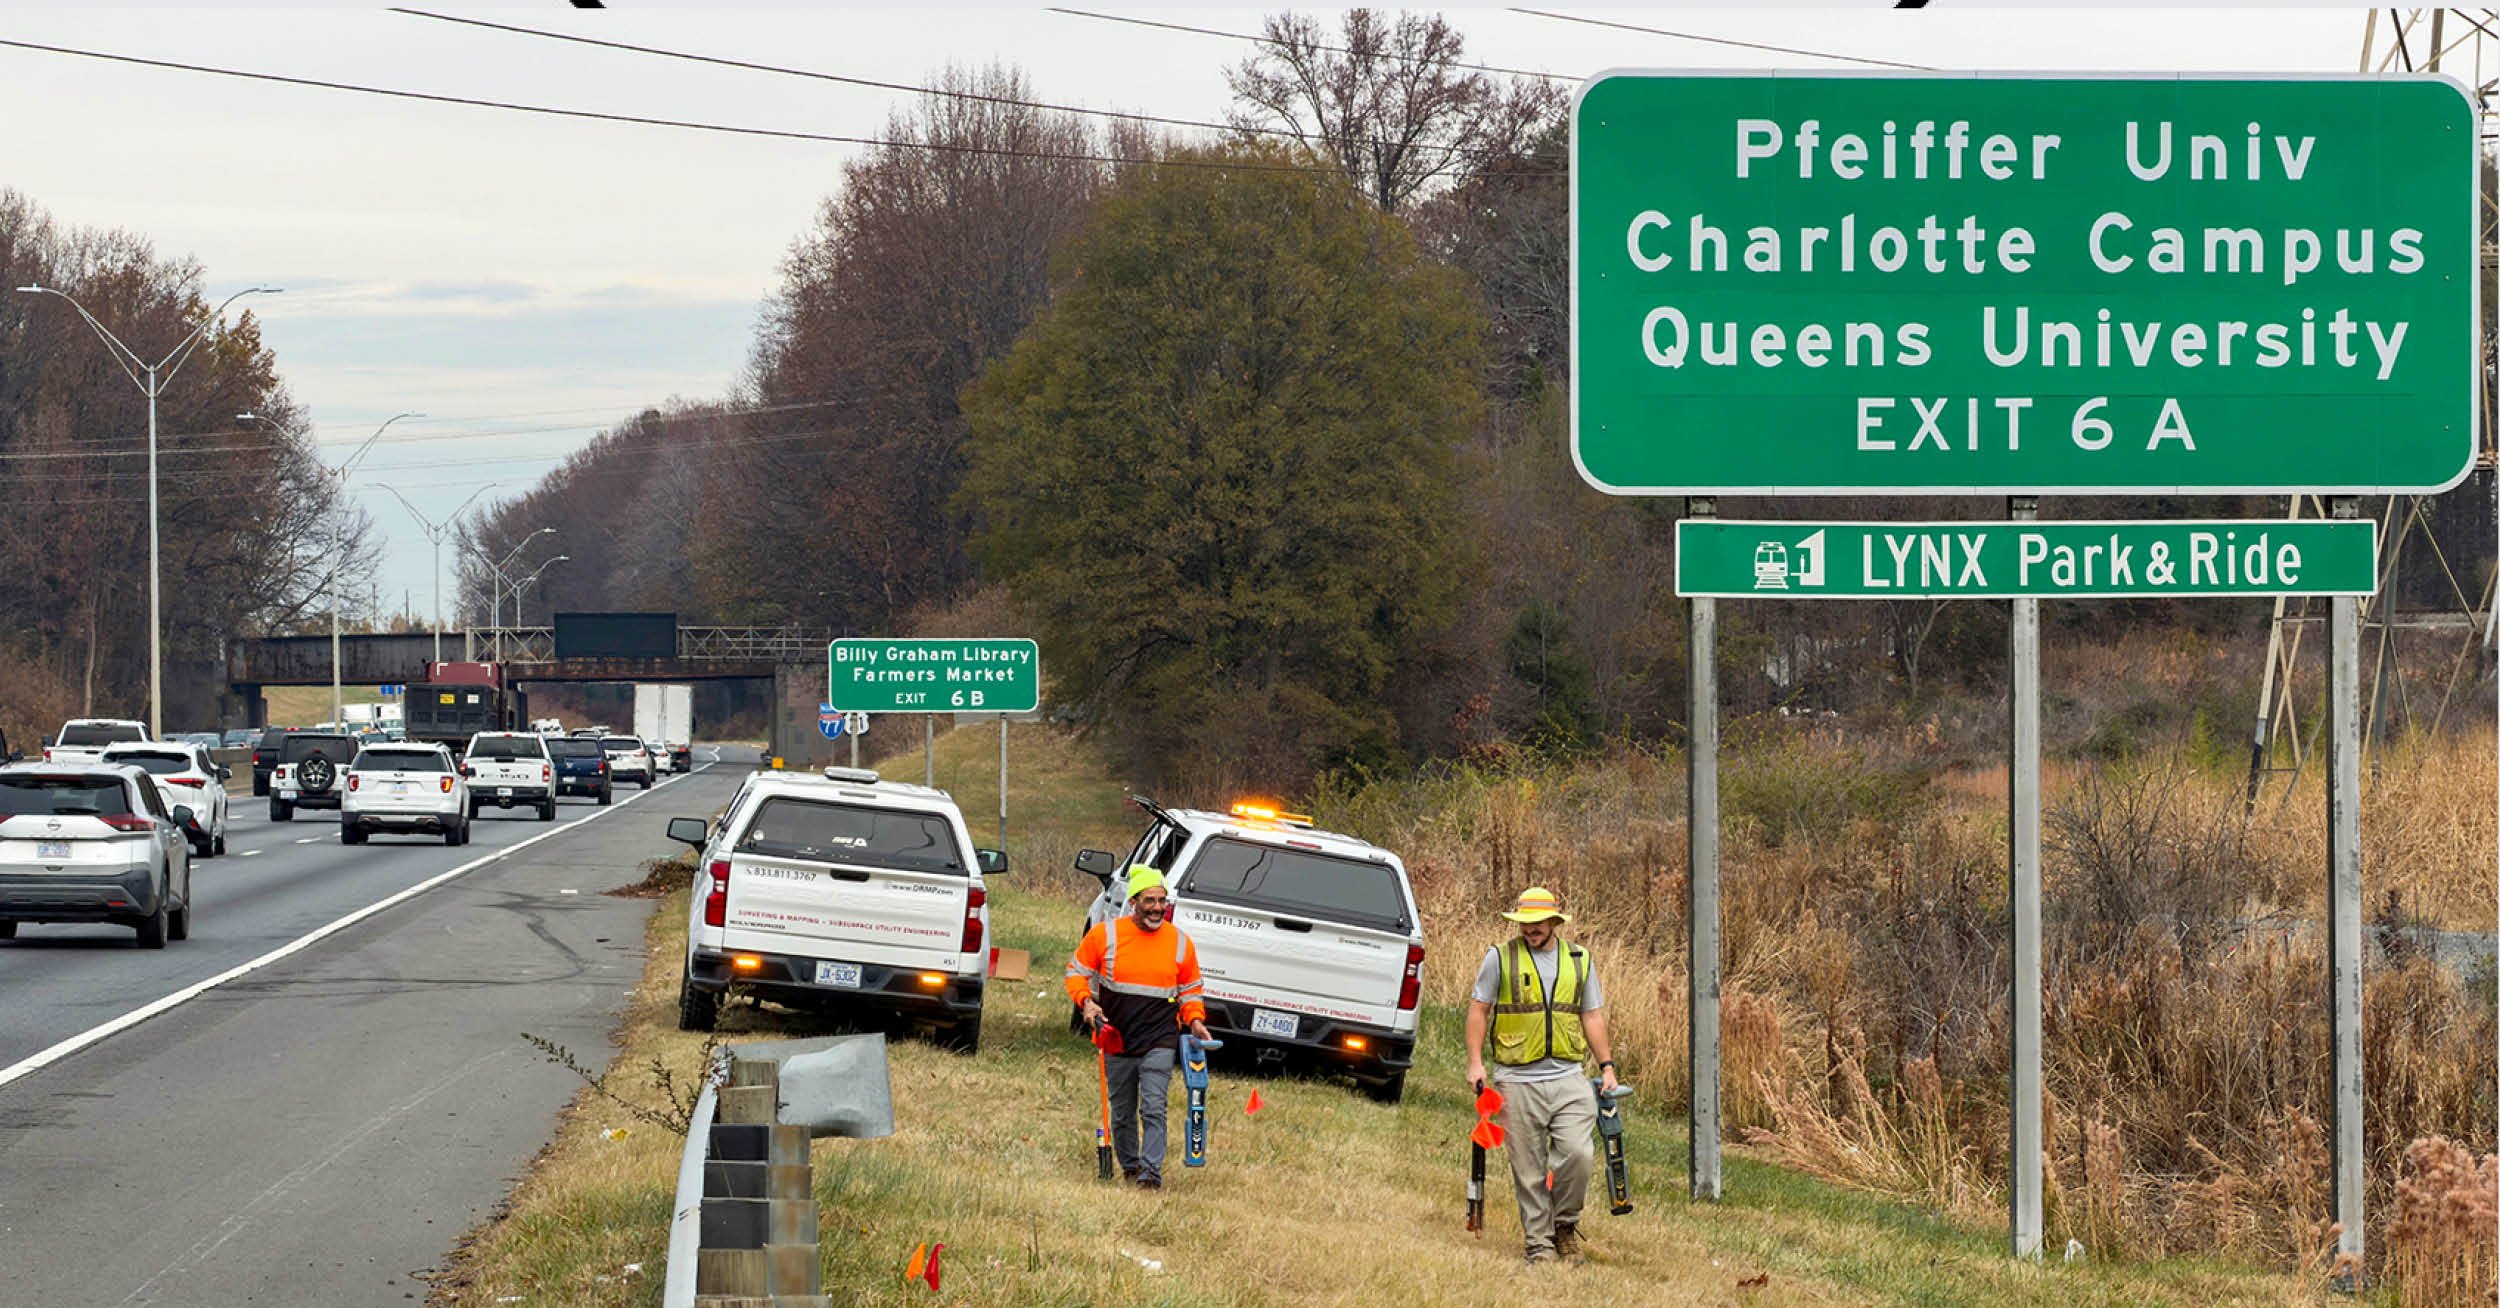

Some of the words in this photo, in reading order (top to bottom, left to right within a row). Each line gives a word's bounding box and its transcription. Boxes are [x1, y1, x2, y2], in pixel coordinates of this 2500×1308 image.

[1737, 119, 2061, 180] Pfeiffer
[2126, 121, 2316, 182] Univ
[1627, 210, 2036, 274] Charlotte
[2089, 212, 2425, 286] Campus
[1641, 306, 1932, 369] Queens
[1983, 306, 2409, 381] University
[1857, 397, 2033, 451] EXIT
[1863, 534, 1987, 587] LYNX
[836, 647, 878, 665] Billy
[886, 646, 957, 662] Graham
[963, 647, 1030, 664] Library
[853, 667, 936, 682] Farmers
[946, 667, 1014, 682] Market
[895, 692, 926, 704] EXIT
[822, 720, 840, 733] 77
[754, 867, 817, 881] 833.811.3767
[738, 909, 777, 920] SURVEYING
[787, 915, 819, 925] MAPPING
[829, 920, 873, 931] SUBSURFACE
[875, 923, 901, 933] UTILITY
[903, 928, 951, 938] ENGINEERING
[1194, 912, 1261, 931] 833.811.3767
[1228, 992, 1257, 1003] MAPPING
[1304, 1004, 1328, 1015] UTILITY
